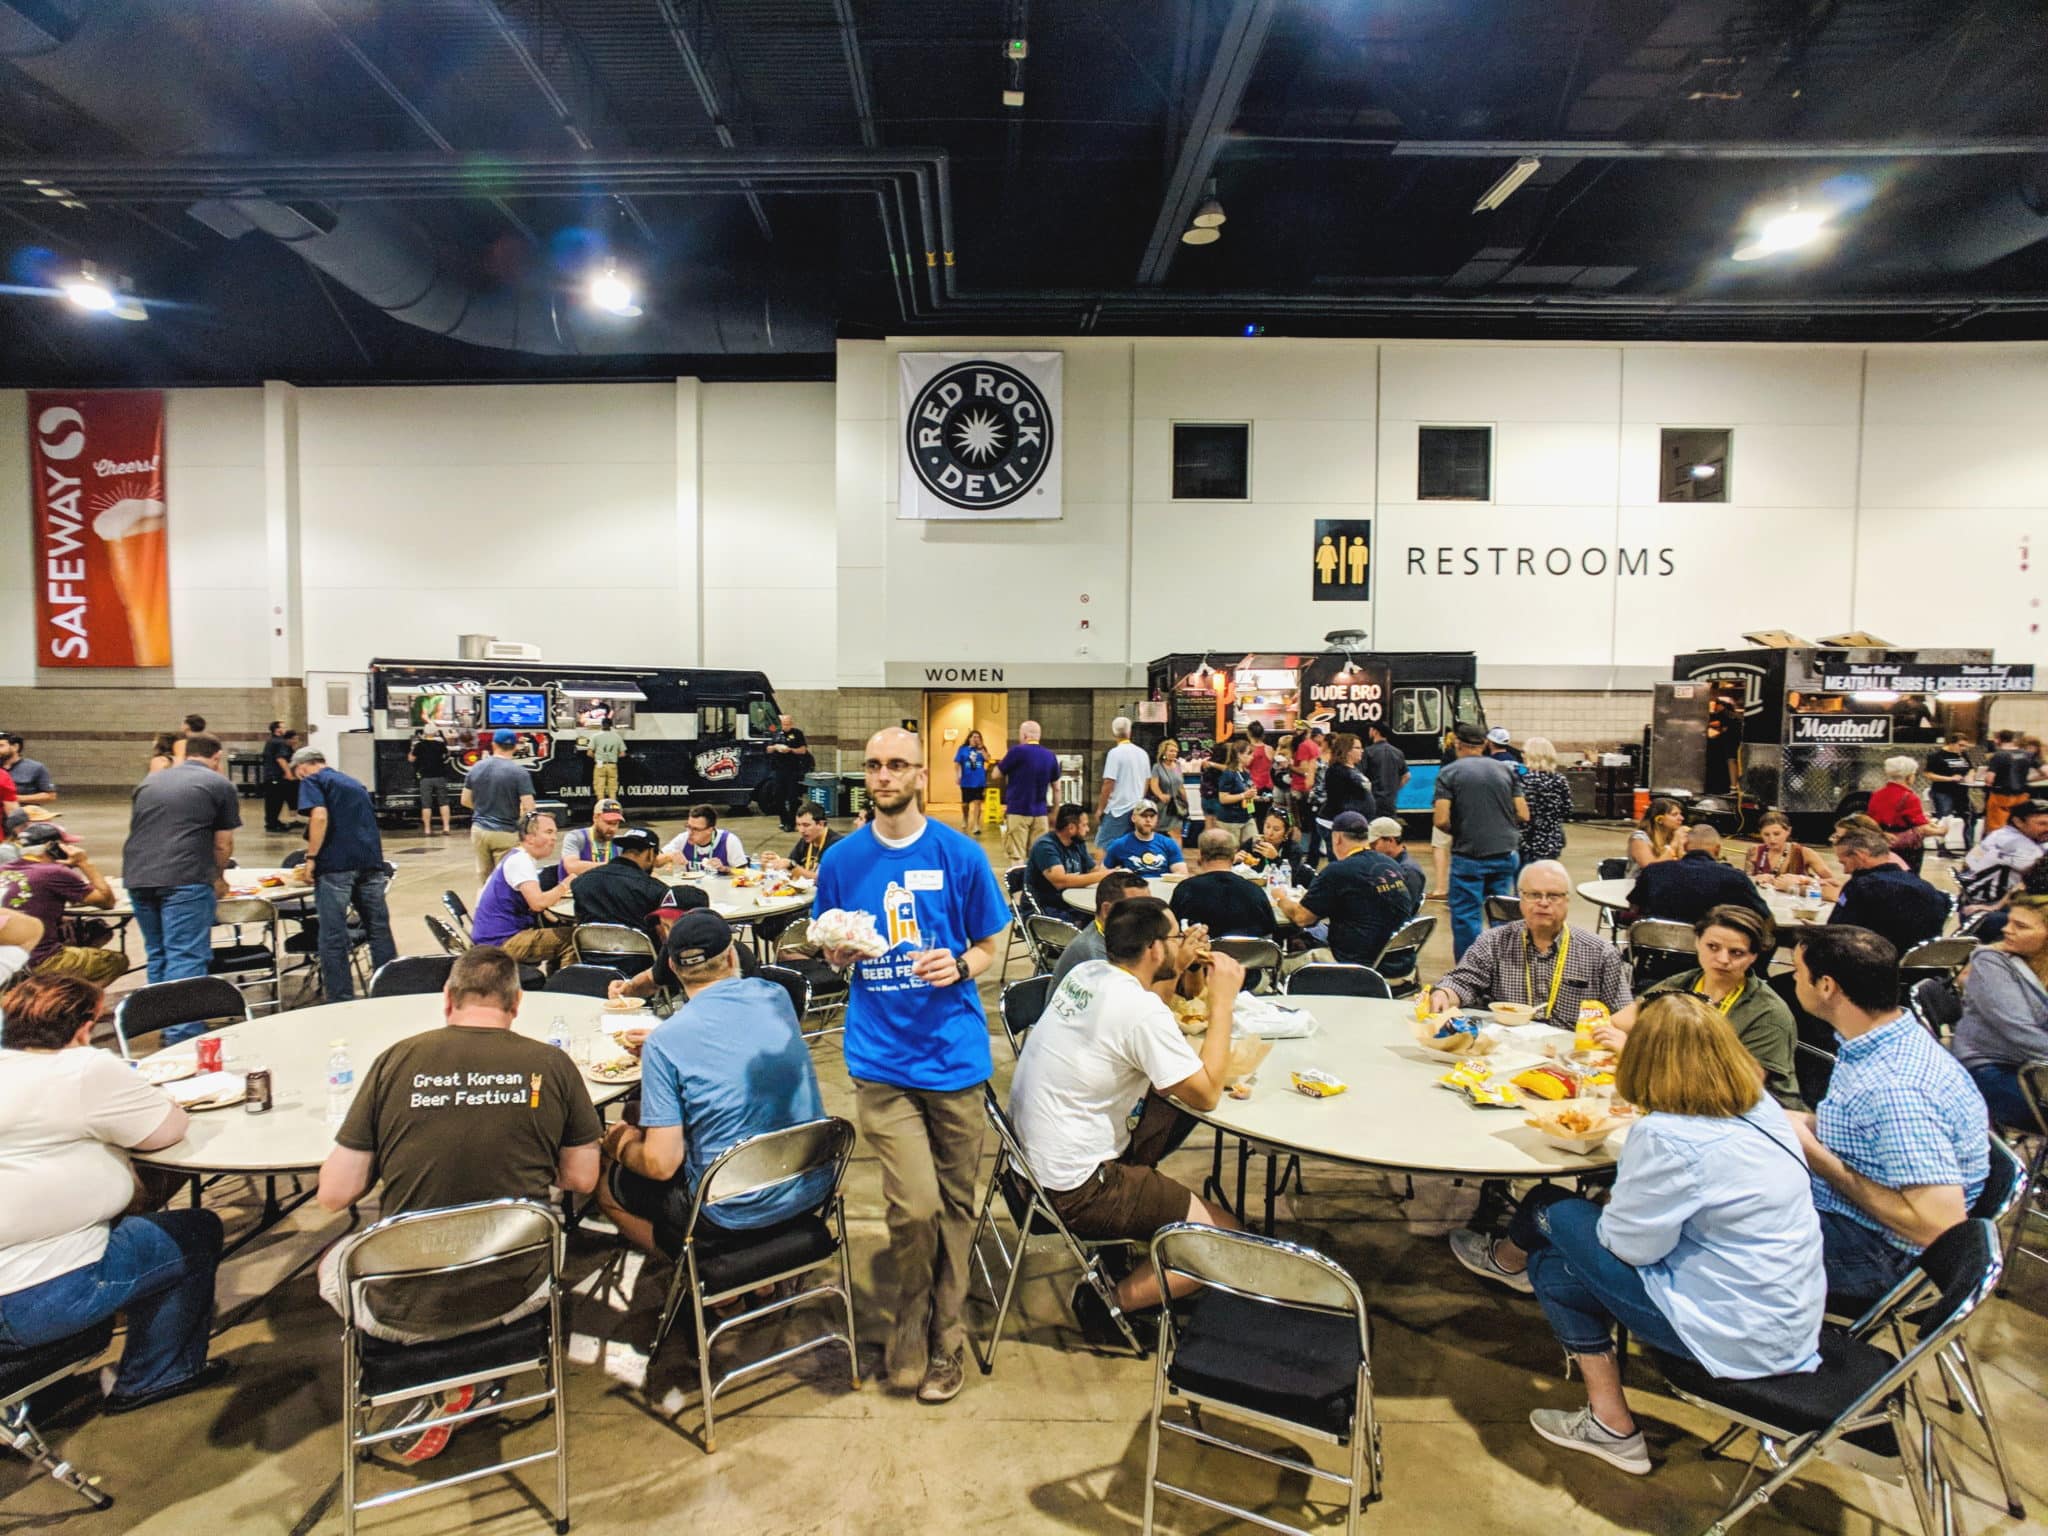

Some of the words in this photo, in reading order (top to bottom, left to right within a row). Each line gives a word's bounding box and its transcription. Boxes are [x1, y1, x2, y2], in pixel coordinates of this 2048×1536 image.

[918, 381, 963, 449] RED
[974, 373, 1041, 449] ROCK
[93, 454, 160, 477] Cheers!
[937, 463, 1023, 498] DELI
[47, 467, 89, 660] SAFEWAY
[1407, 546, 1675, 576] RESTROOMS
[925, 668, 1004, 682] WOMEN
[1824, 675, 1888, 691] MEATBALL
[1937, 676, 2033, 692] CHEESESTEAKS
[1310, 684, 1348, 701] DUDE
[1350, 684, 1382, 701] BRO
[1336, 702, 1382, 723] TACO
[1796, 717, 1887, 738] Meatball
[560, 786, 591, 797] CAJUN
[627, 785, 669, 796] COLORADO
[670, 785, 689, 796] KICK
[862, 967, 894, 981] BEER
[413, 1072, 461, 1088] Great
[467, 1072, 523, 1087] Korean
[410, 1093, 450, 1108] Beer
[455, 1089, 528, 1105] Festival
